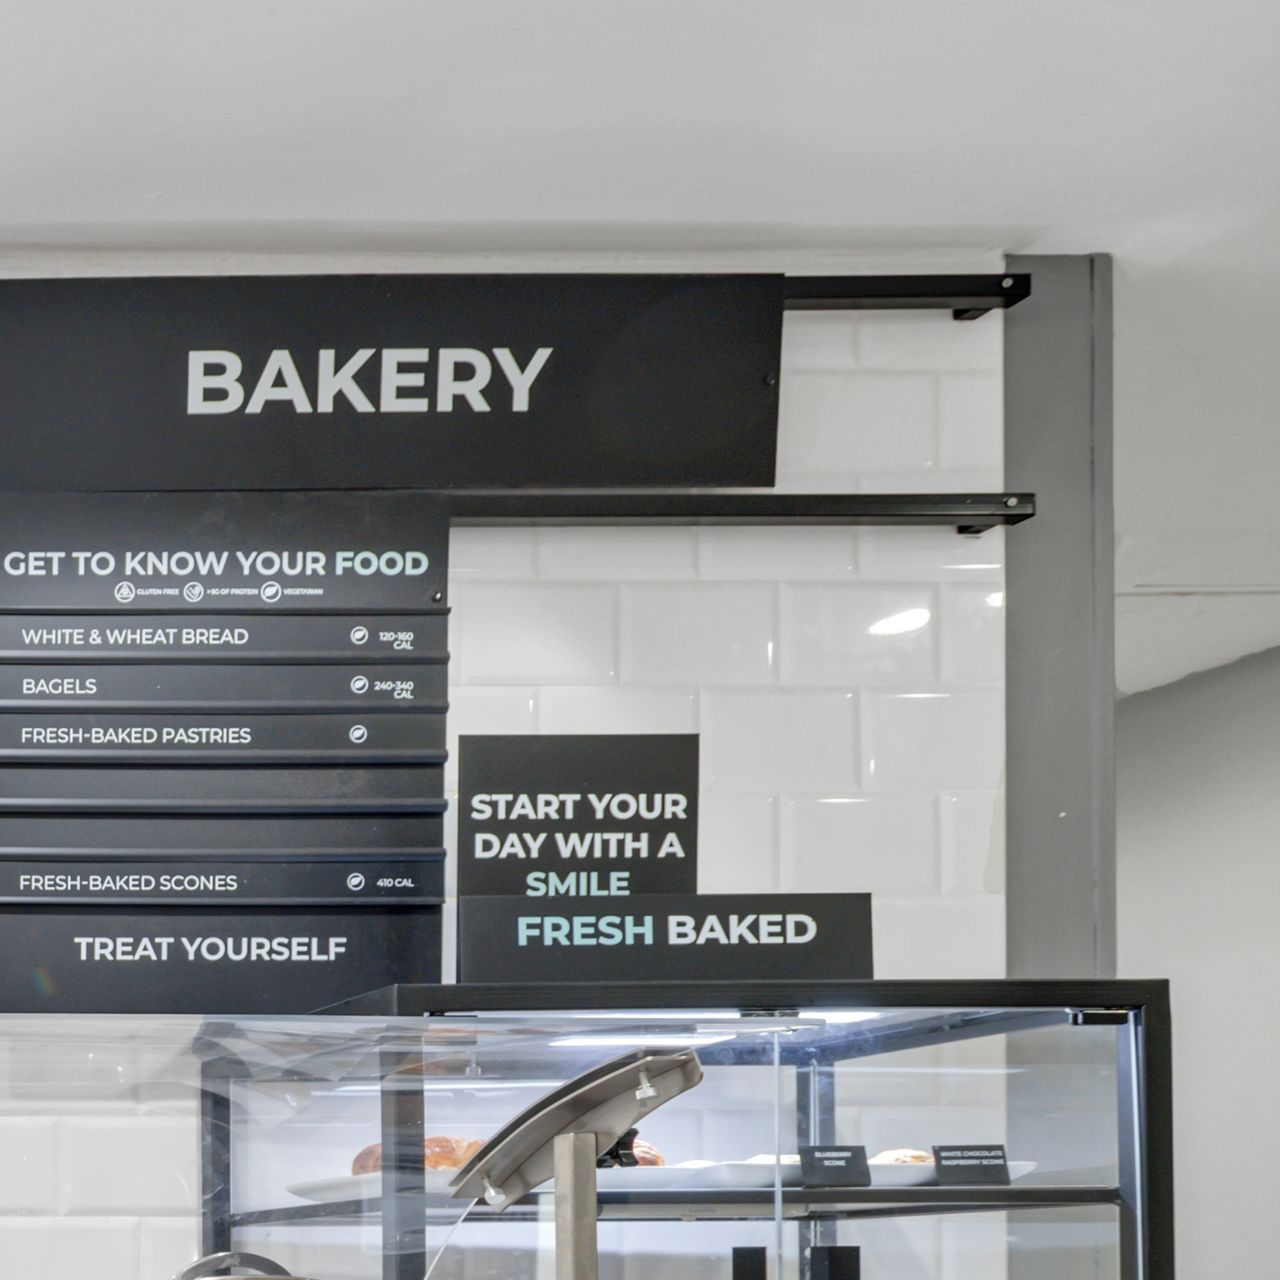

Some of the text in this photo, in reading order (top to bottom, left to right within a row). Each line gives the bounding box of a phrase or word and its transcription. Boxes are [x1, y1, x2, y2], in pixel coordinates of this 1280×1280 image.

[187, 348, 553, 414] BAKERY
[4, 551, 428, 576] GET TO KNOW YOUR FOOD
[22, 629, 248, 644] WHITE & WHEAT BREAD
[379, 632, 414, 641] 120-160
[393, 641, 414, 650] CAL
[23, 679, 97, 694] BAGELS
[374, 681, 414, 690] 240-340
[393, 690, 414, 699] CAL
[22, 728, 251, 743] FRESH-BAKED PASTRIES
[471, 794, 687, 820] START YOUR
[475, 833, 685, 858] DAY WITH A
[20, 875, 237, 890] FRESH-BAKED SCONES
[377, 878, 414, 887] 410 CAL
[526, 872, 630, 896] SMILE
[518, 914, 817, 946] FRESH BAKED
[74, 937, 347, 960] TREAT YOURSELF
